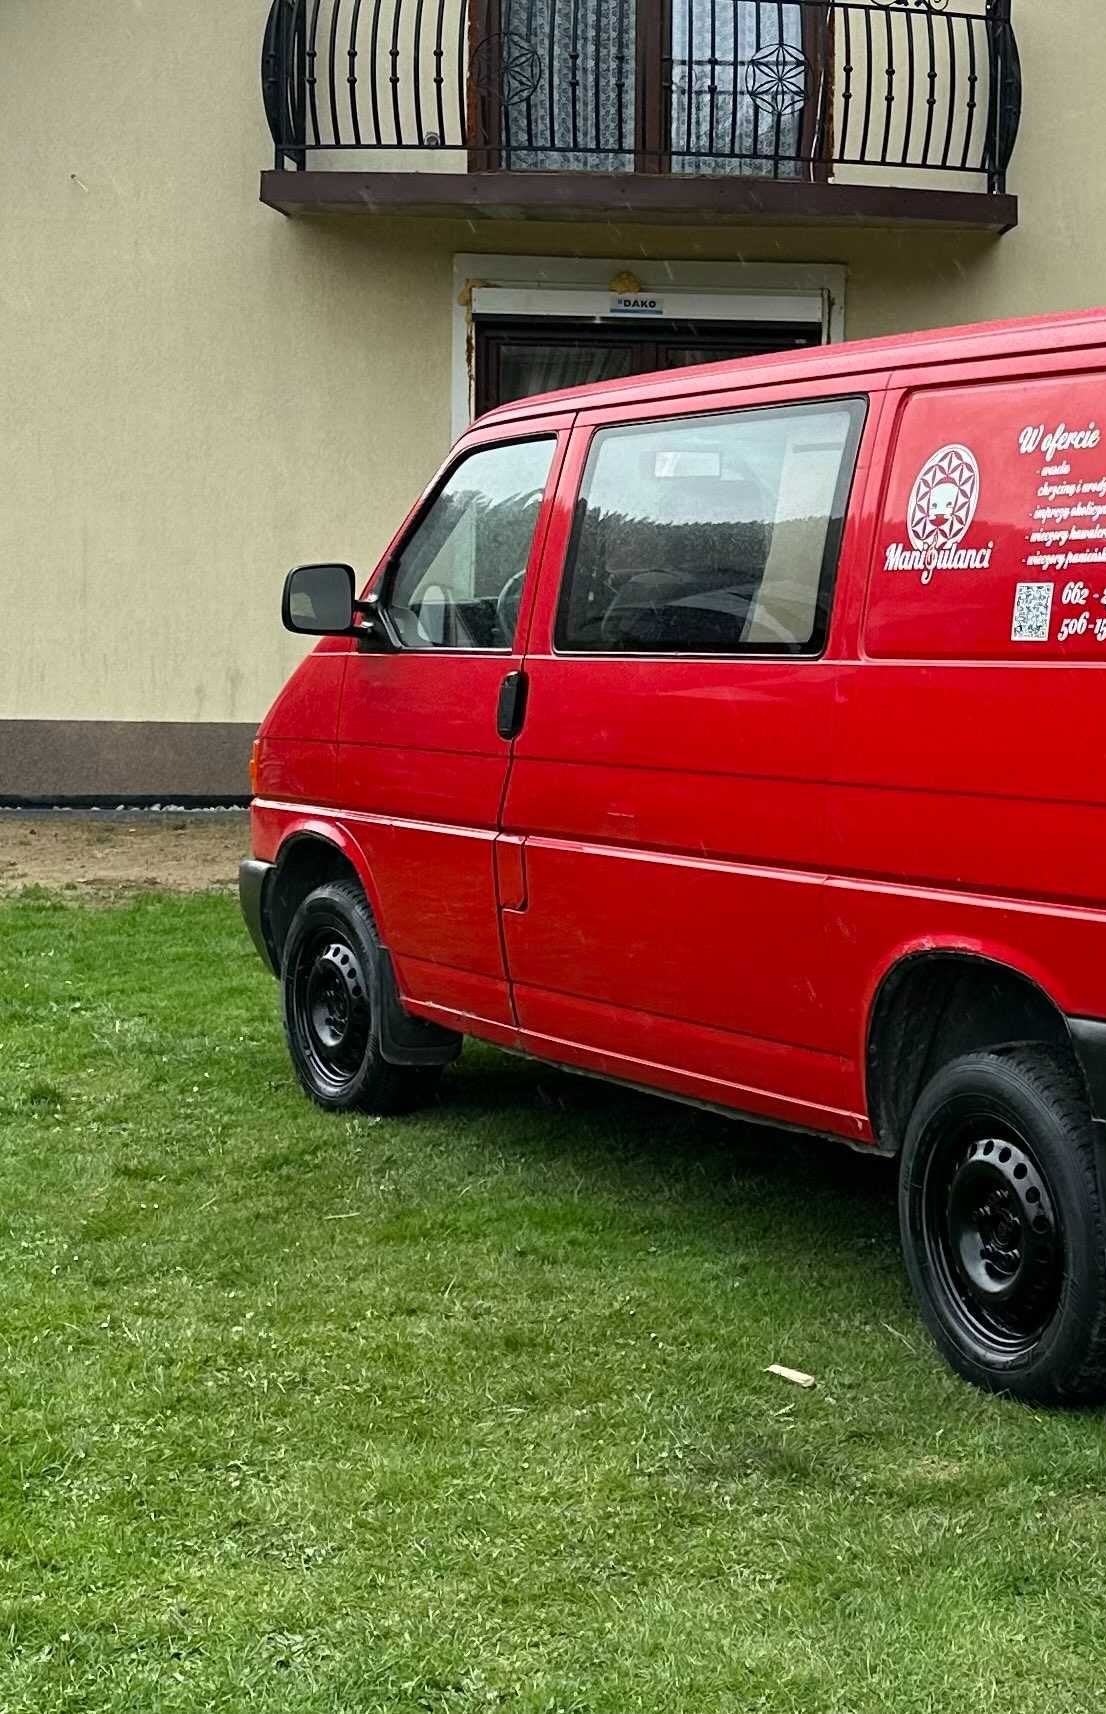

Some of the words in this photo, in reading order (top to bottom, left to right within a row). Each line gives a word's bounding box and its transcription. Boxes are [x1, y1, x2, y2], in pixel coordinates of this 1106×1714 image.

[623, 299, 657, 309] DAKO
[1018, 423, 1045, 454] W
[1041, 421, 1101, 462] ofercie
